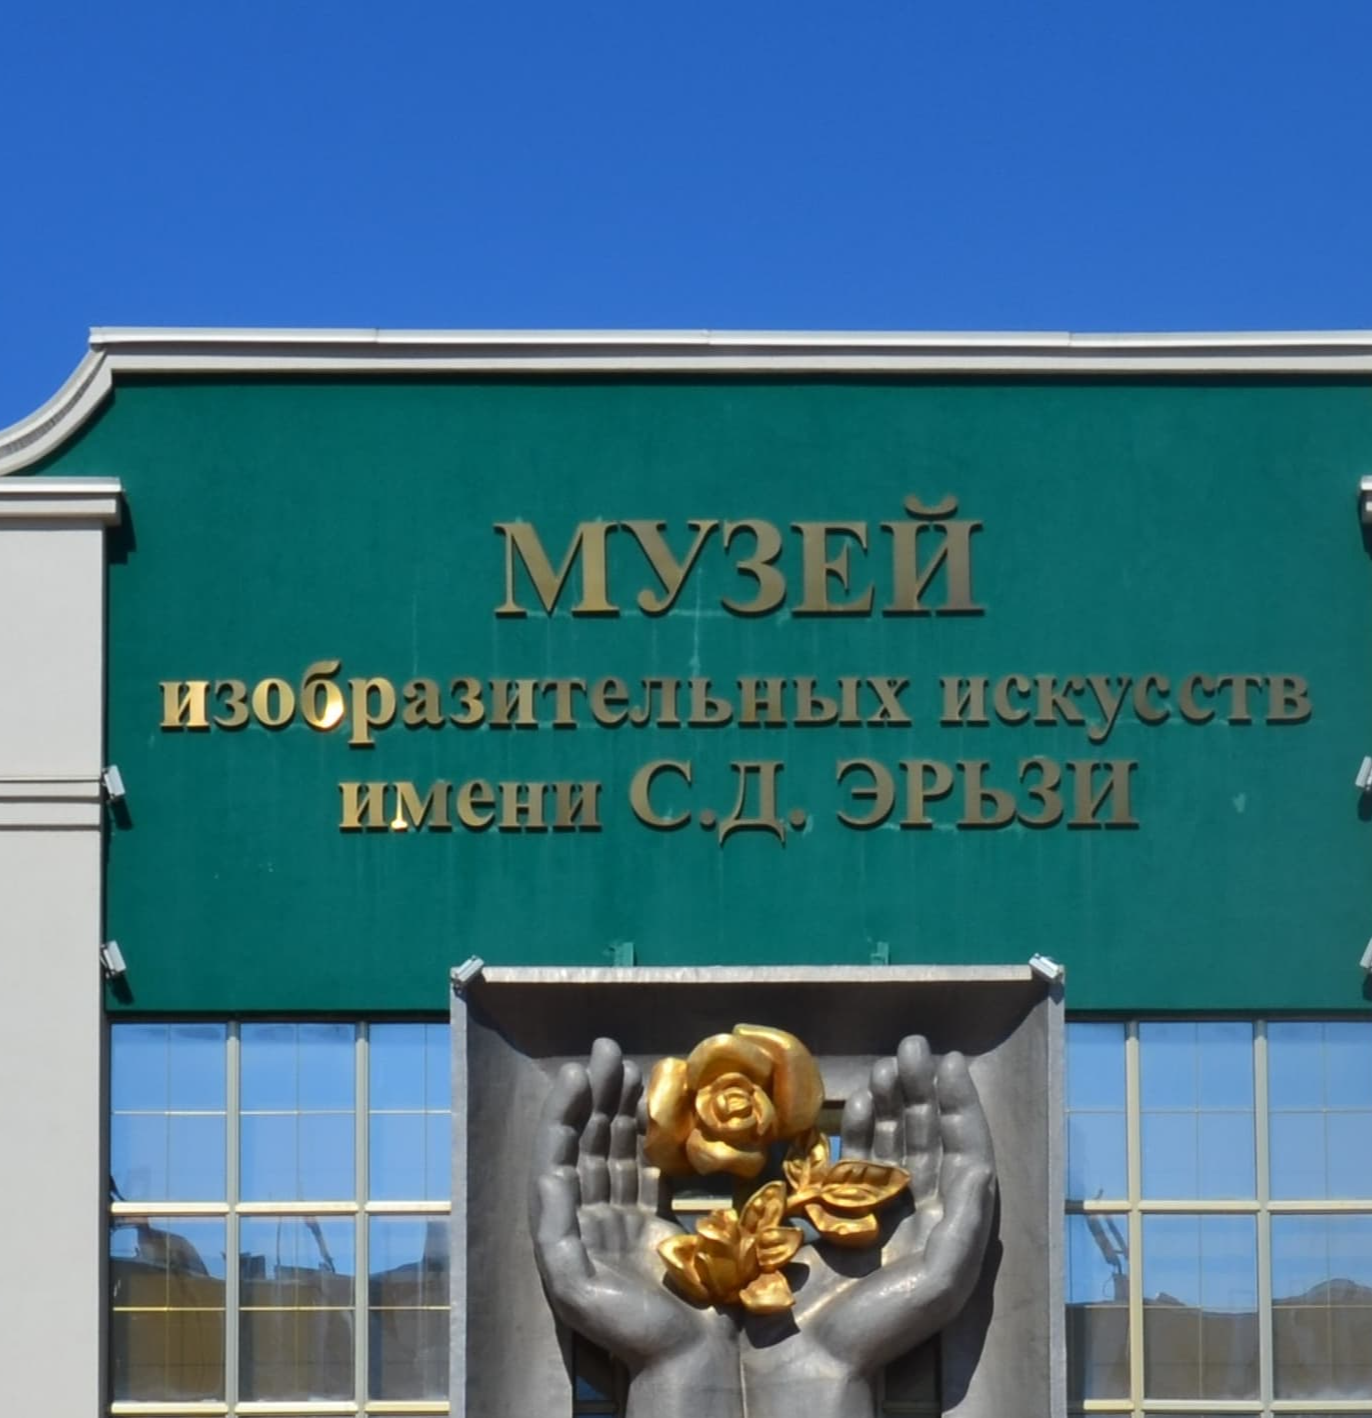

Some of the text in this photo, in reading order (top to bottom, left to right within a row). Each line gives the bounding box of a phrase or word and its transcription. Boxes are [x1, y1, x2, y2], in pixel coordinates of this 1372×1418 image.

[493, 495, 985, 617] МУЗЕЙ
[159, 659, 1313, 748] изобразительных искусств
[339, 757, 1140, 849] имени С.Д. ЭРЬЗИ
